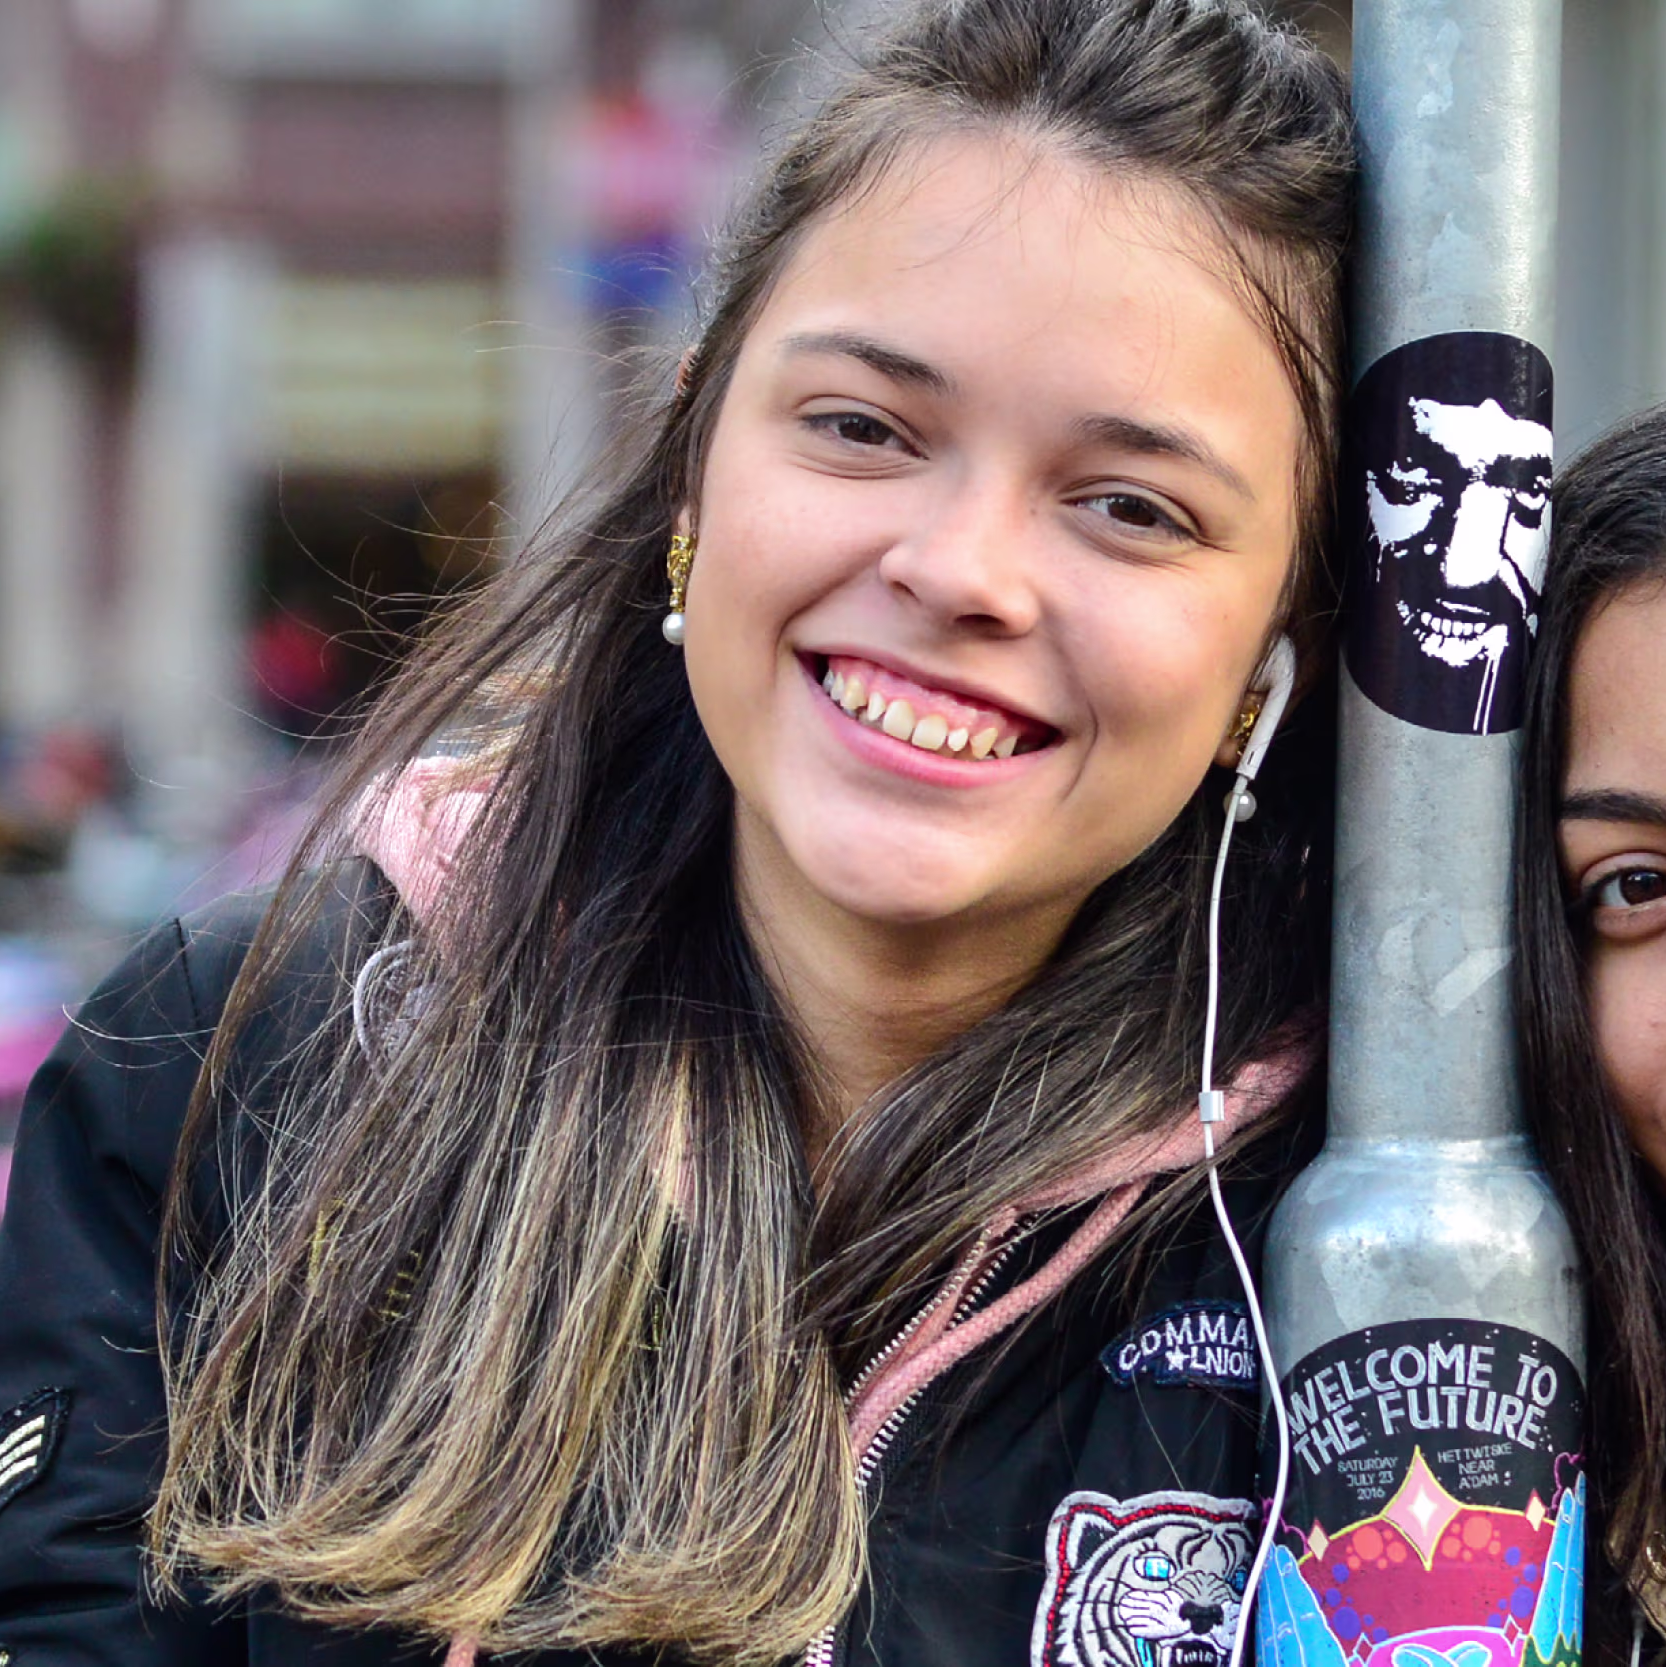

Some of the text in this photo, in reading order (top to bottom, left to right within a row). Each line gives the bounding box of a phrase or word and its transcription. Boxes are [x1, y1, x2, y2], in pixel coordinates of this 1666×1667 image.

[1286, 1340, 1558, 1435] WELCOME TO
[1293, 1386, 1546, 1475] THE FUTURE
[1337, 1457, 1398, 1473] SATURDAY
[1458, 1459, 1495, 1475] NEAR
[1346, 1470, 1394, 1487] JULY 23
[1458, 1473, 1499, 1490] A'DAM
[1356, 1487, 1385, 1501] 2016
